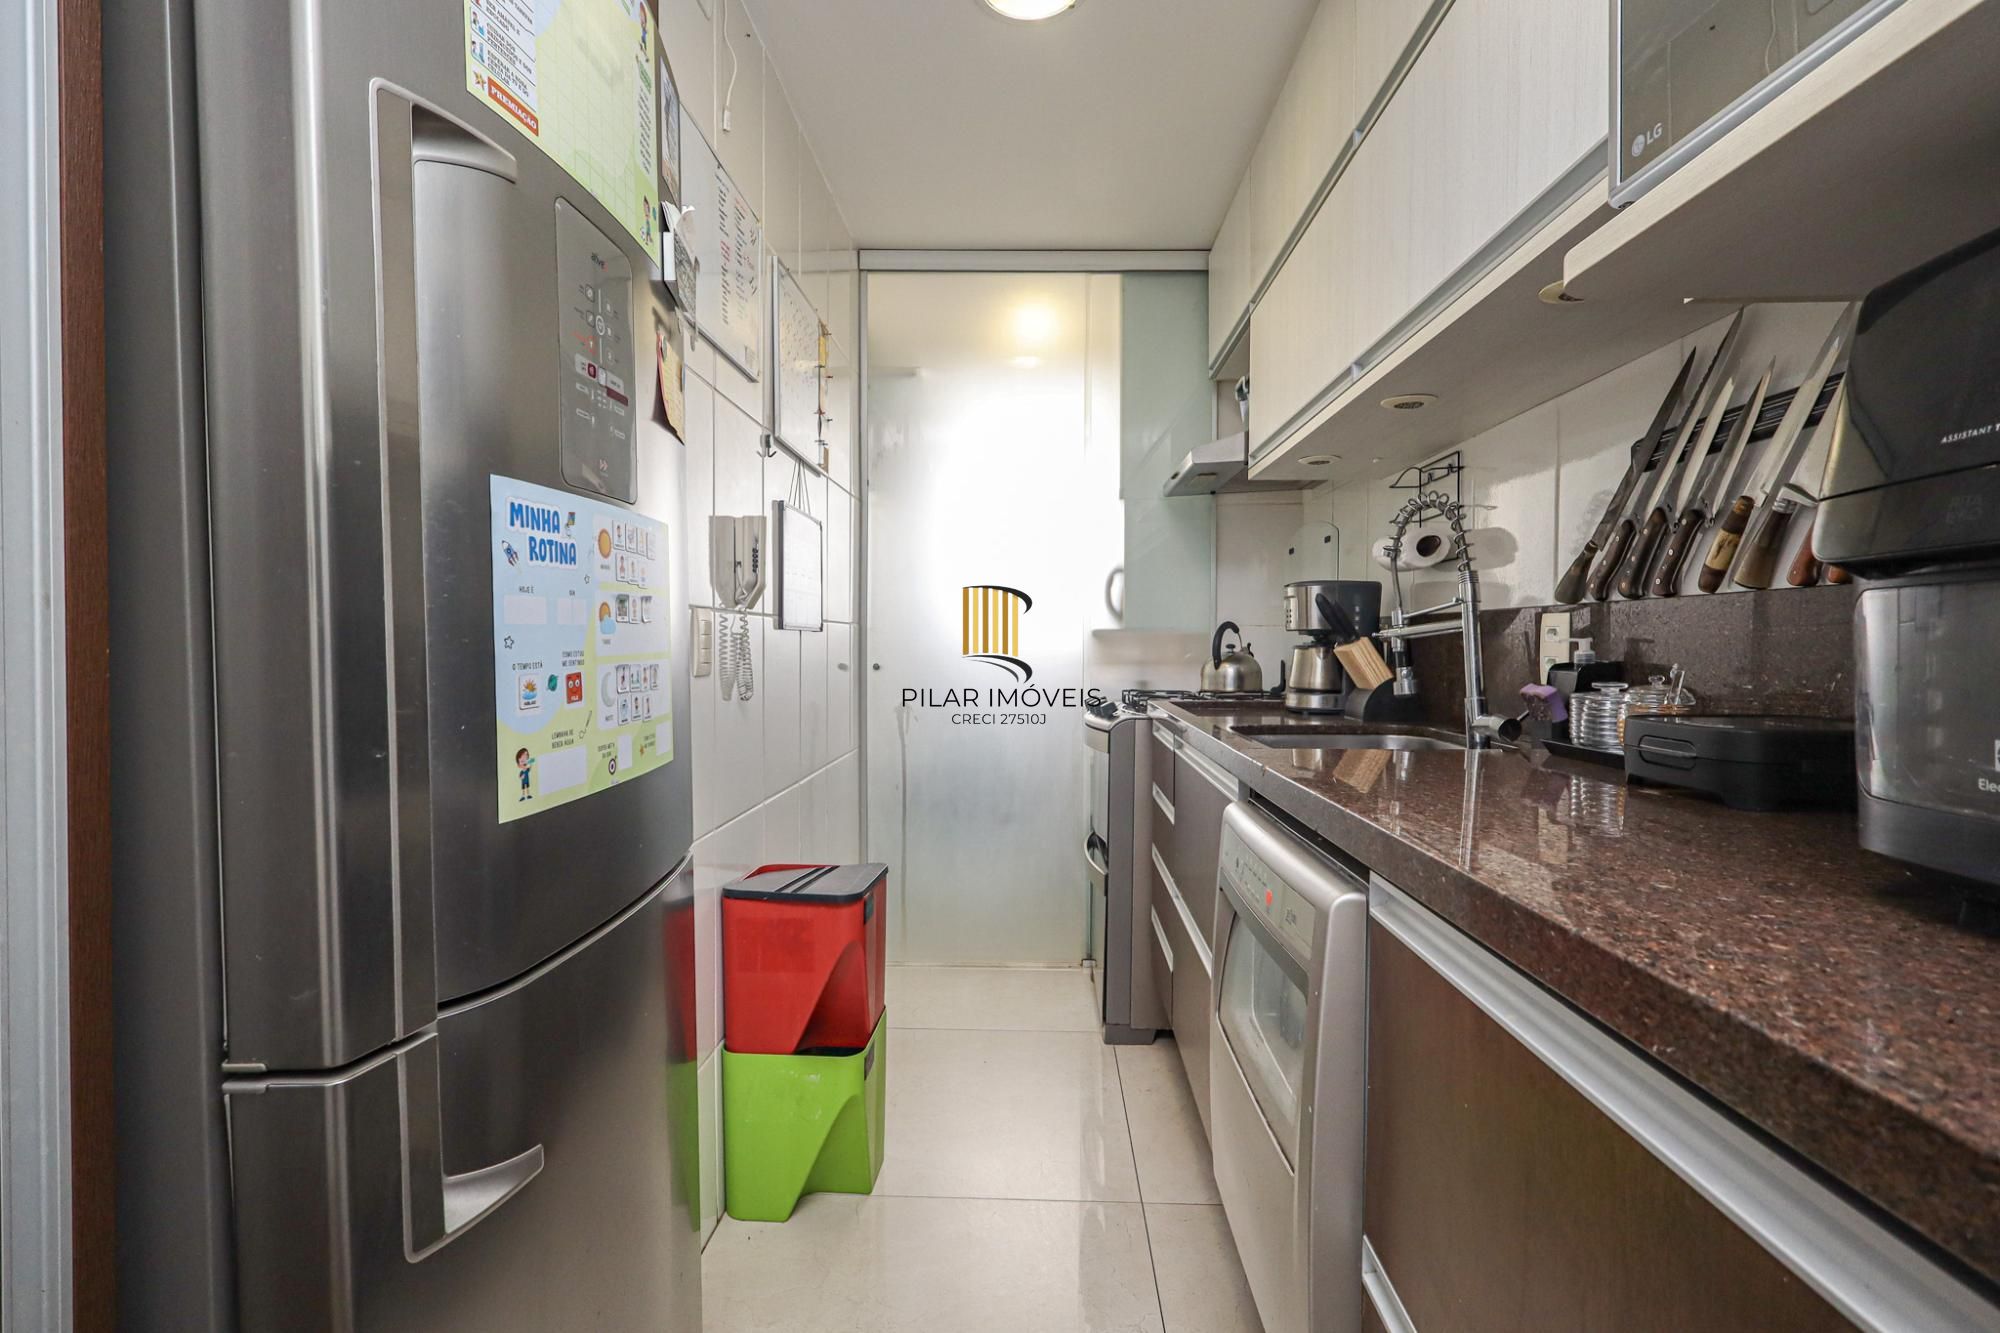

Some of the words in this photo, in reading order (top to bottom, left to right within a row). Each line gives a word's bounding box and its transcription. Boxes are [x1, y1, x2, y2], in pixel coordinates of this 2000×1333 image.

[490, 85, 538, 130] PREMIAÇÃO
[1646, 122, 1664, 145] LG
[1940, 424, 1993, 444] ASSISTANT
[509, 501, 560, 534] MINHA
[528, 535, 577, 566] ROTINA
